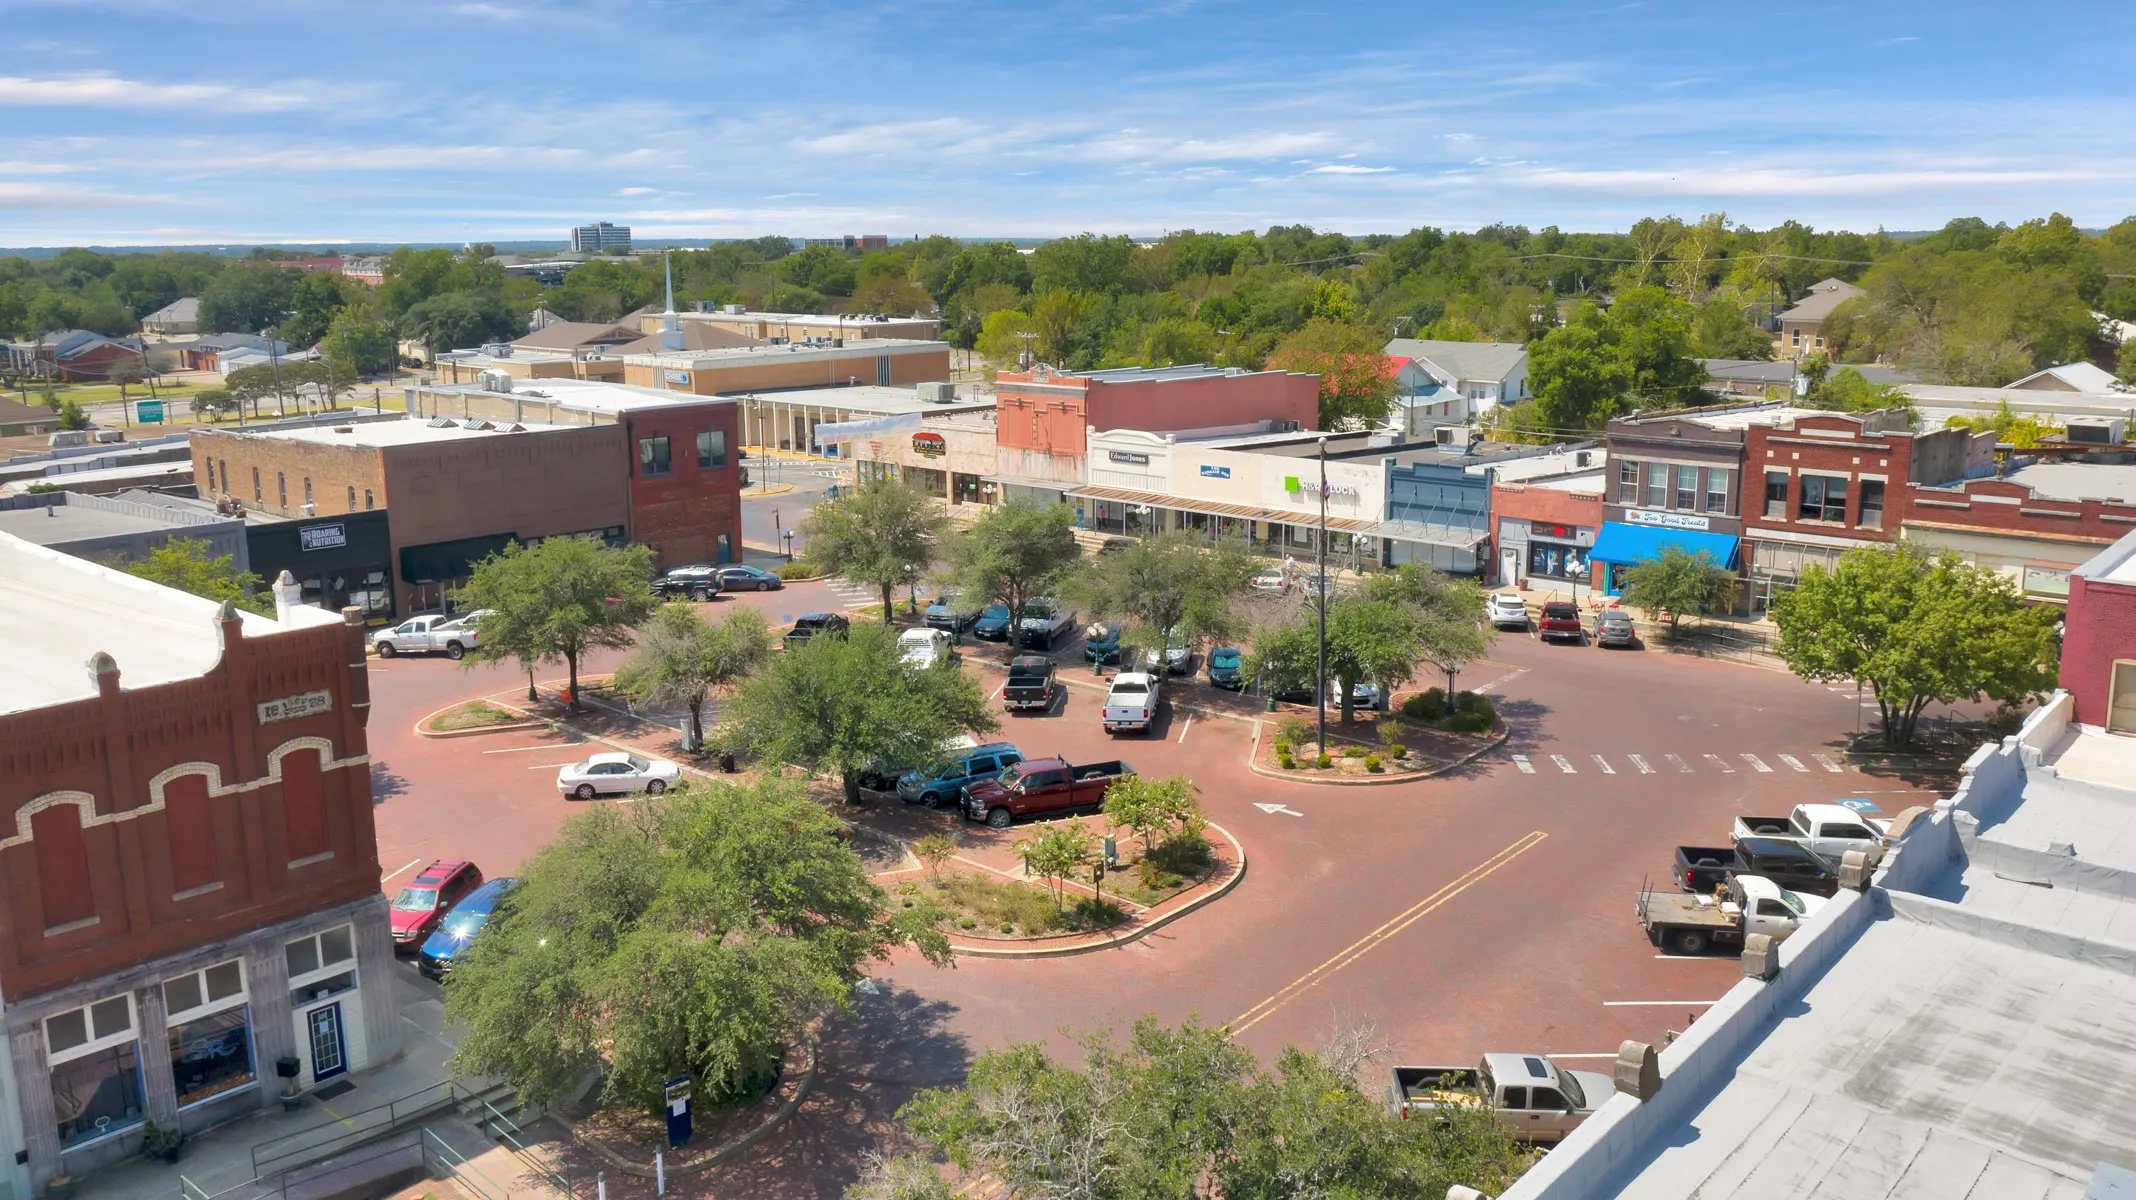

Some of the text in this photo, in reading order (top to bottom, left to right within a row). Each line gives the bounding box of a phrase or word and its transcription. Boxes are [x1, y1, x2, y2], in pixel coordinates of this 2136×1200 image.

[1110, 451, 1146, 462] Edward Jones
[1302, 482, 1355, 496] H&R LOCK
[311, 527, 340, 539] ROARING
[311, 534, 345, 547] NUTRITION
